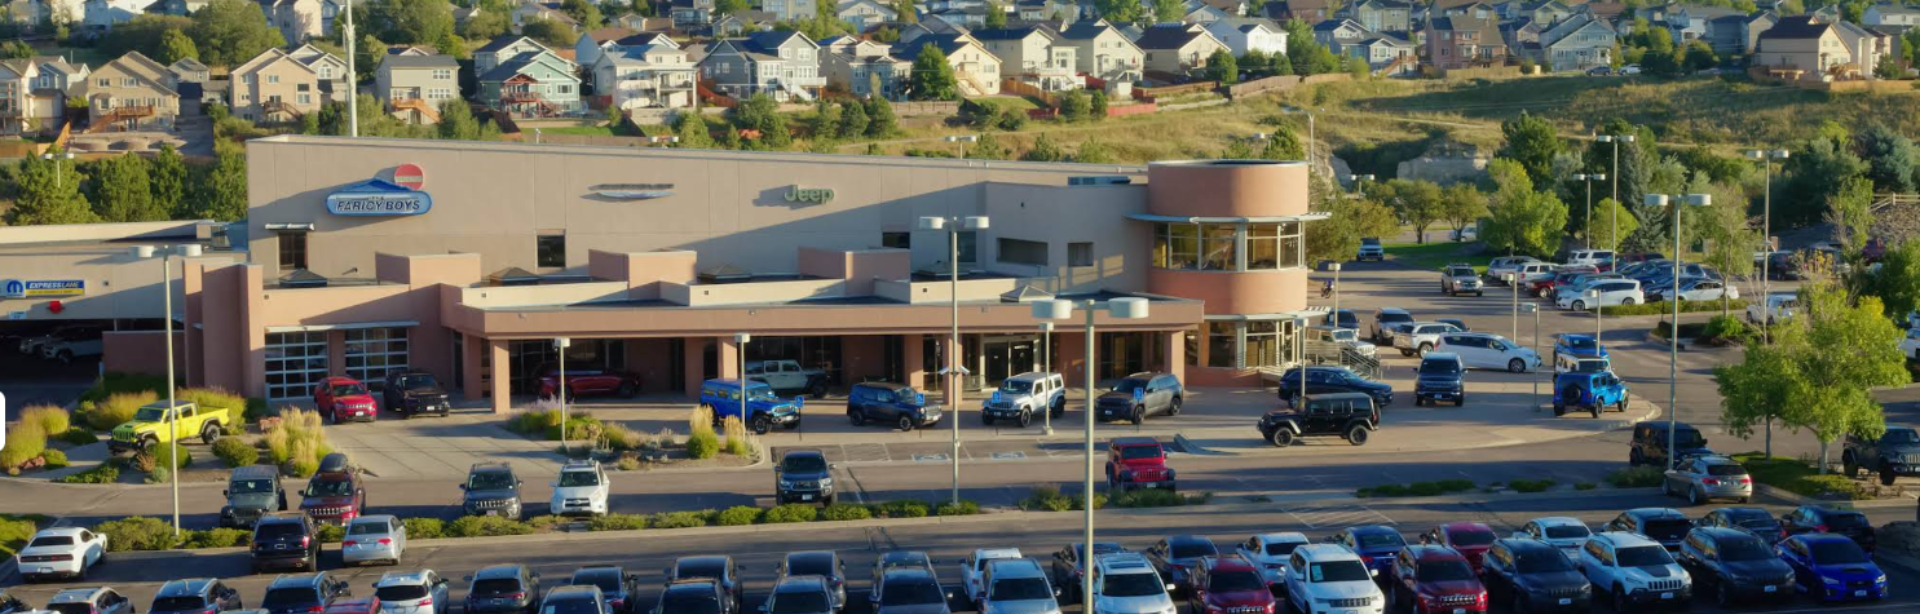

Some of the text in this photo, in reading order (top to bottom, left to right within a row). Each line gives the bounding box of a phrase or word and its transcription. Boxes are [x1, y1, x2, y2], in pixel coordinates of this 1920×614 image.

[784, 184, 834, 204] Jeep
[337, 200, 420, 211] FARICY BOYS
